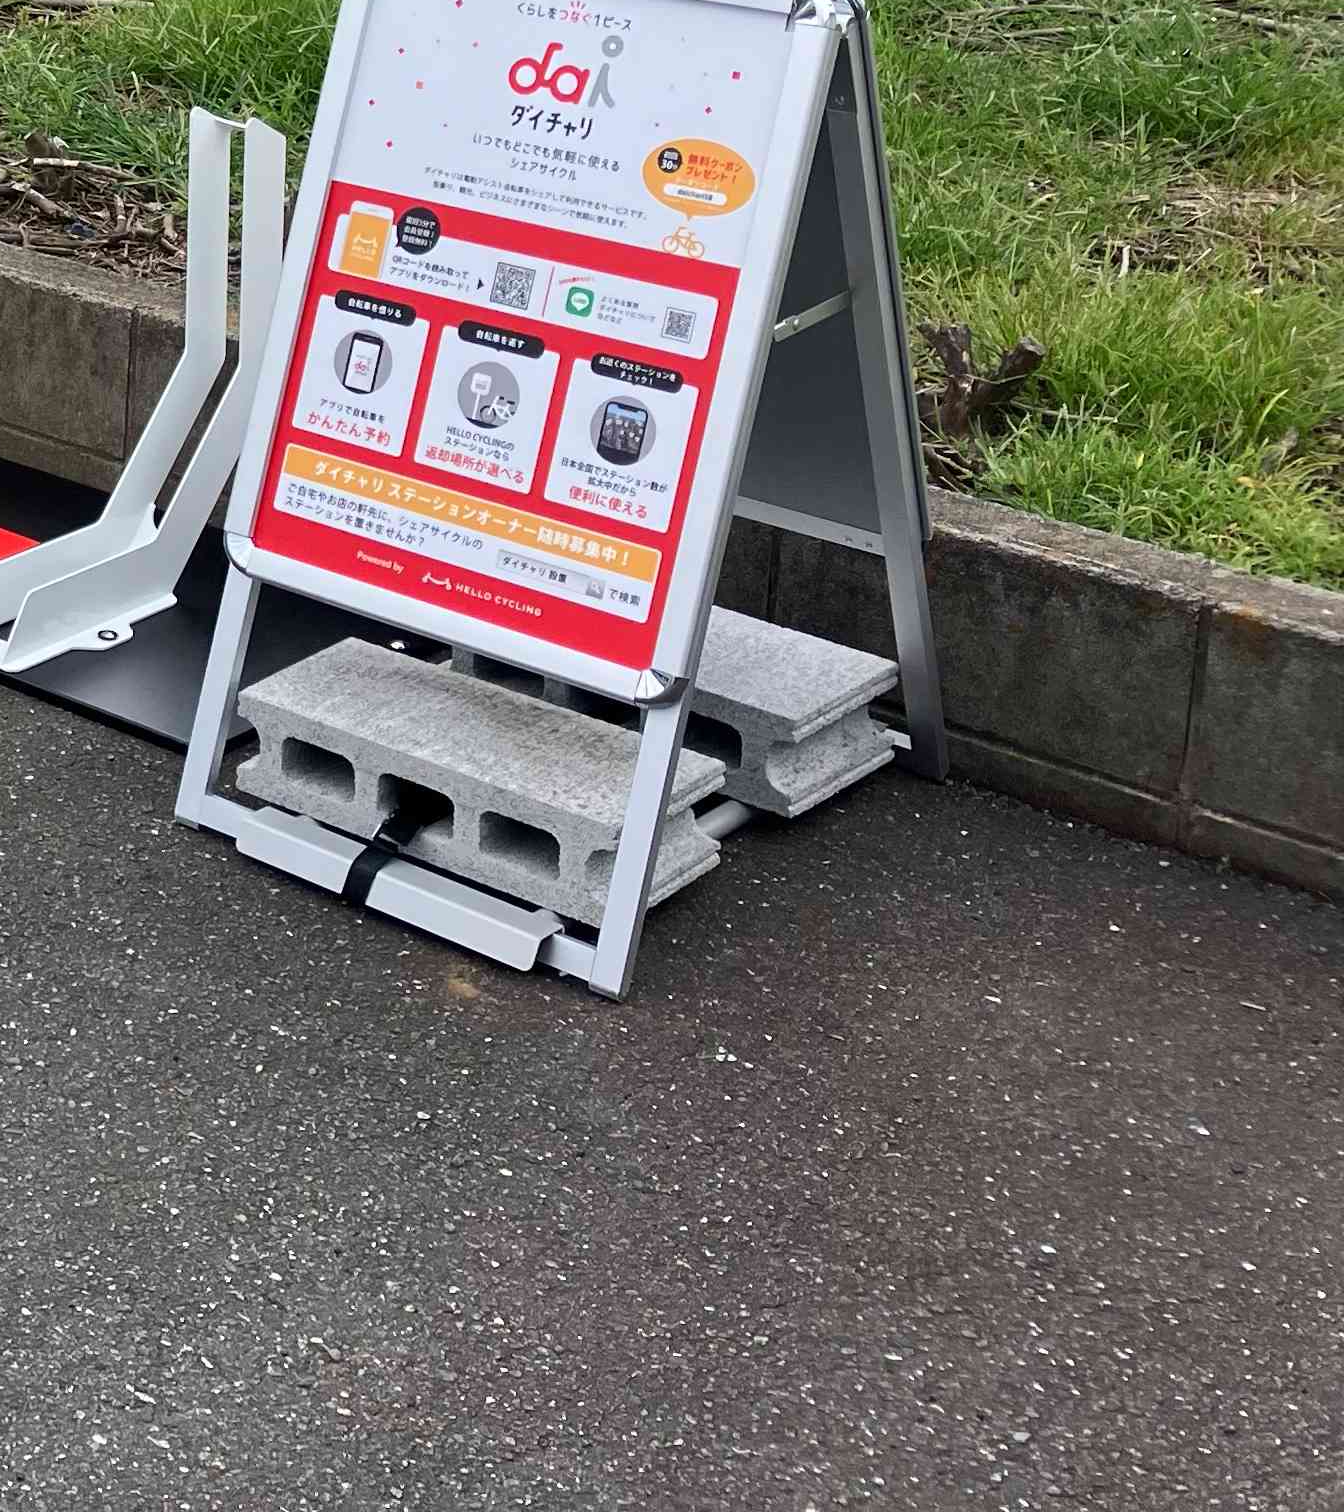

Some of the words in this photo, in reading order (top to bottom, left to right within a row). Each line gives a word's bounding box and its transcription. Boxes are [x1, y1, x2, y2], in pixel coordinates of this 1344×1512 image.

[508, 34, 625, 109] dai
[511, 104, 593, 140] ダイチャリ
[472, 132, 622, 173] いつでもどこでも気軽に使える
[510, 157, 578, 182] シェアサイクル
[319, 397, 386, 423] アプリで自転車を
[307, 411, 391, 447] かんたん予約
[424, 444, 525, 485] 返却場所が選べる
[444, 436, 510, 462] ステーションなら
[314, 460, 384, 493] ダイチャリ
[587, 476, 637, 498] 拡大中だから
[569, 486, 648, 520] 便利に使える
[356, 550, 393, 569] Powered
[392, 562, 405, 575] by
[455, 582, 492, 601] HELLO
[494, 595, 543, 617] CYCLING
[608, 587, 641, 607] で検索
